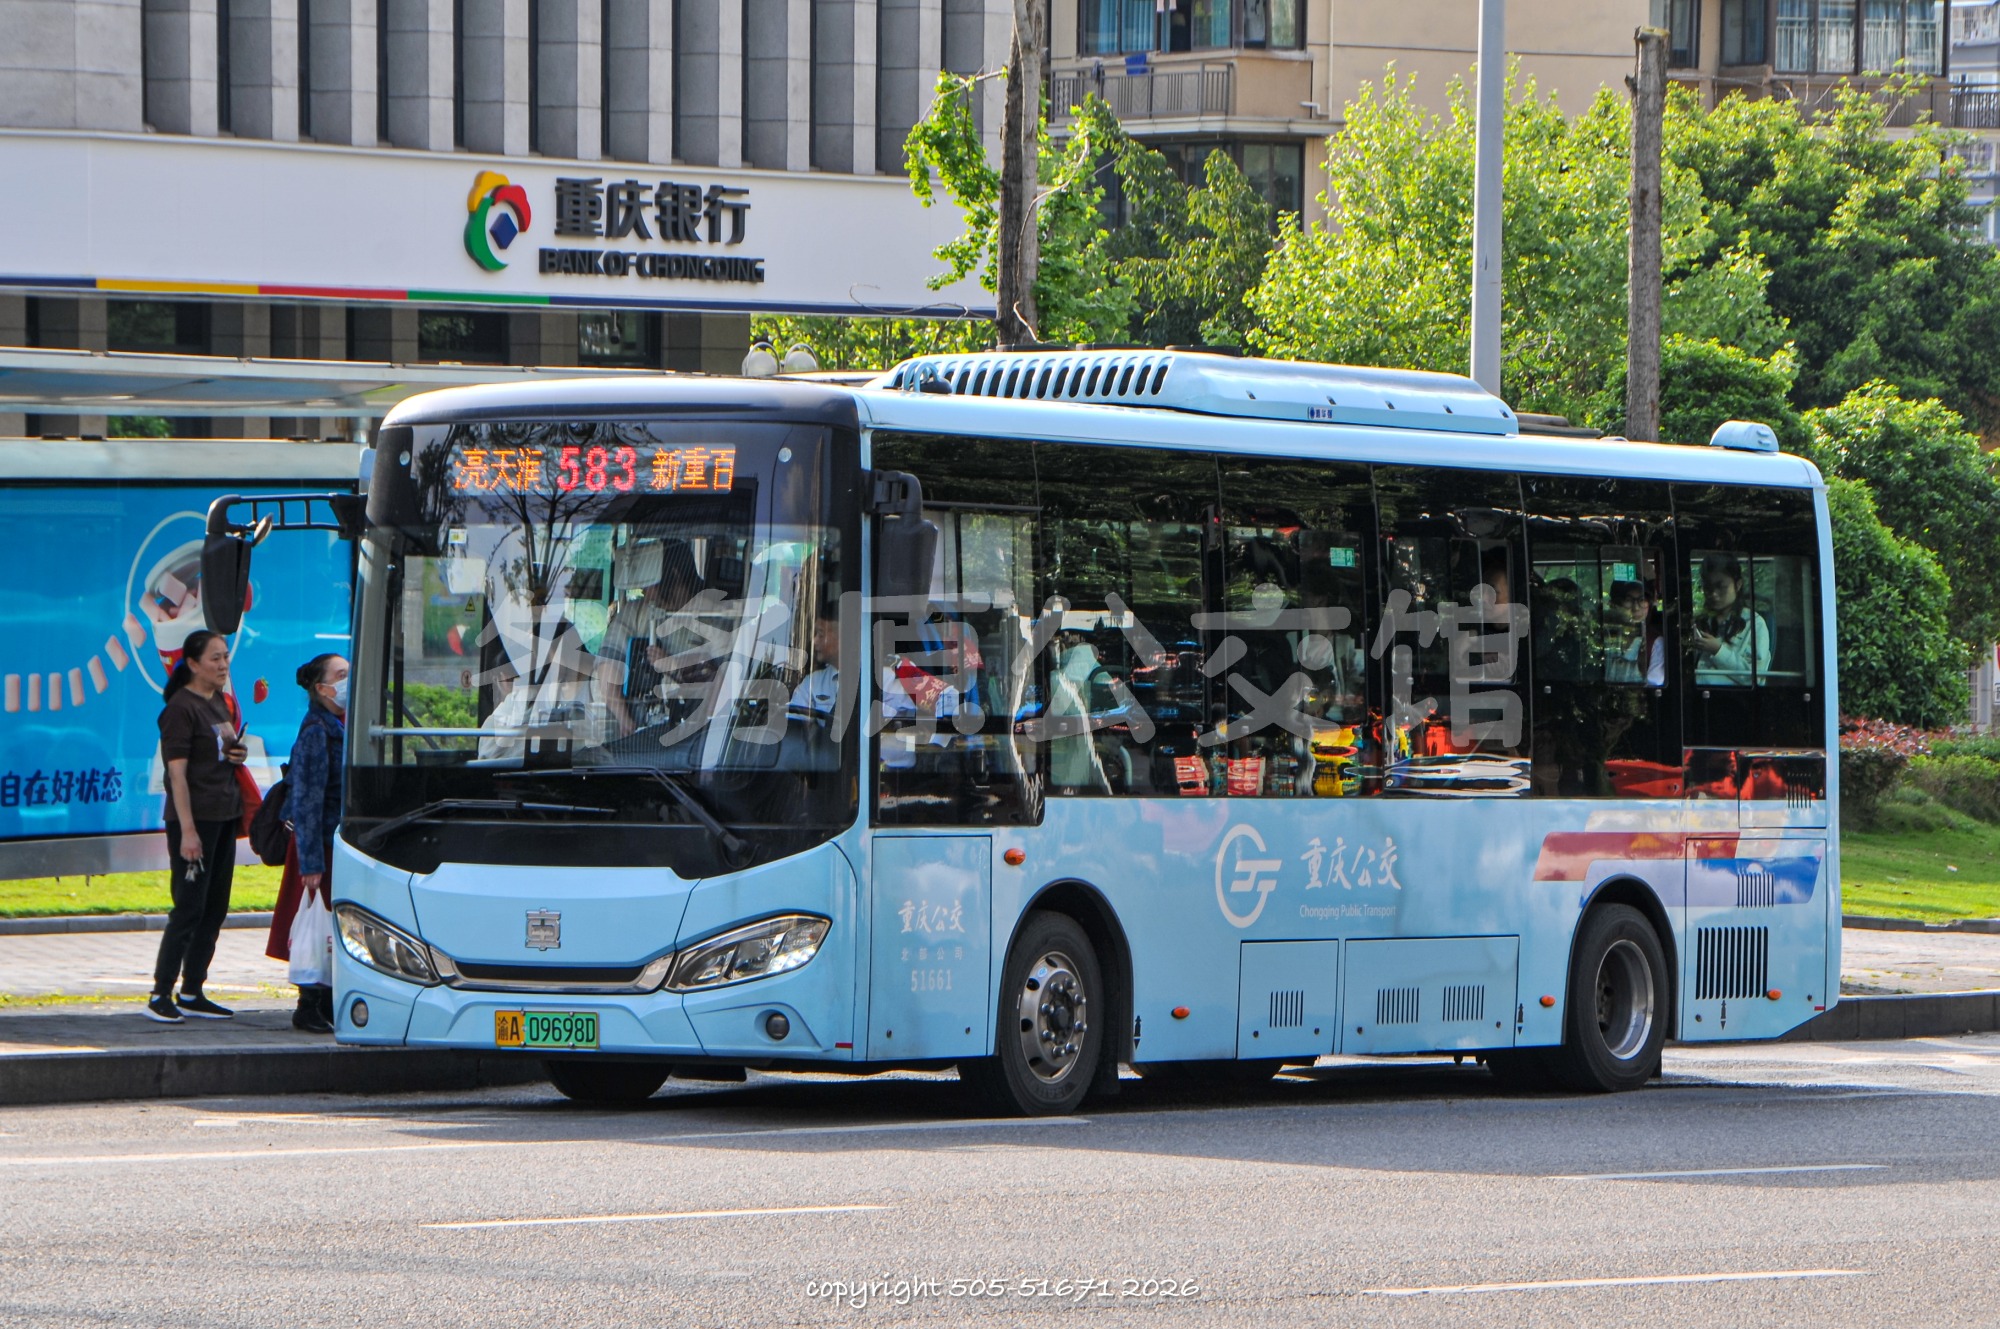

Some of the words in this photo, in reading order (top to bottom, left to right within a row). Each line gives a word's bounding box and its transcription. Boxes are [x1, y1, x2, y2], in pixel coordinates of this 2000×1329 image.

[554, 177, 751, 245] 重庆银行
[539, 247, 604, 275] BANK
[603, 250, 637, 277] OF
[636, 252, 765, 283] CHONGQING
[557, 446, 636, 491] 583
[651, 447, 736, 490] 新重百
[0, 766, 123, 807] 自在好状态
[1300, 837, 1402, 890] 重庆公交
[898, 900, 965, 933] 重庆公交
[1300, 904, 1340, 919] Chongqing
[1341, 904, 1362, 917] Public
[1363, 904, 1397, 918] Transport
[911, 969, 952, 992] 51661
